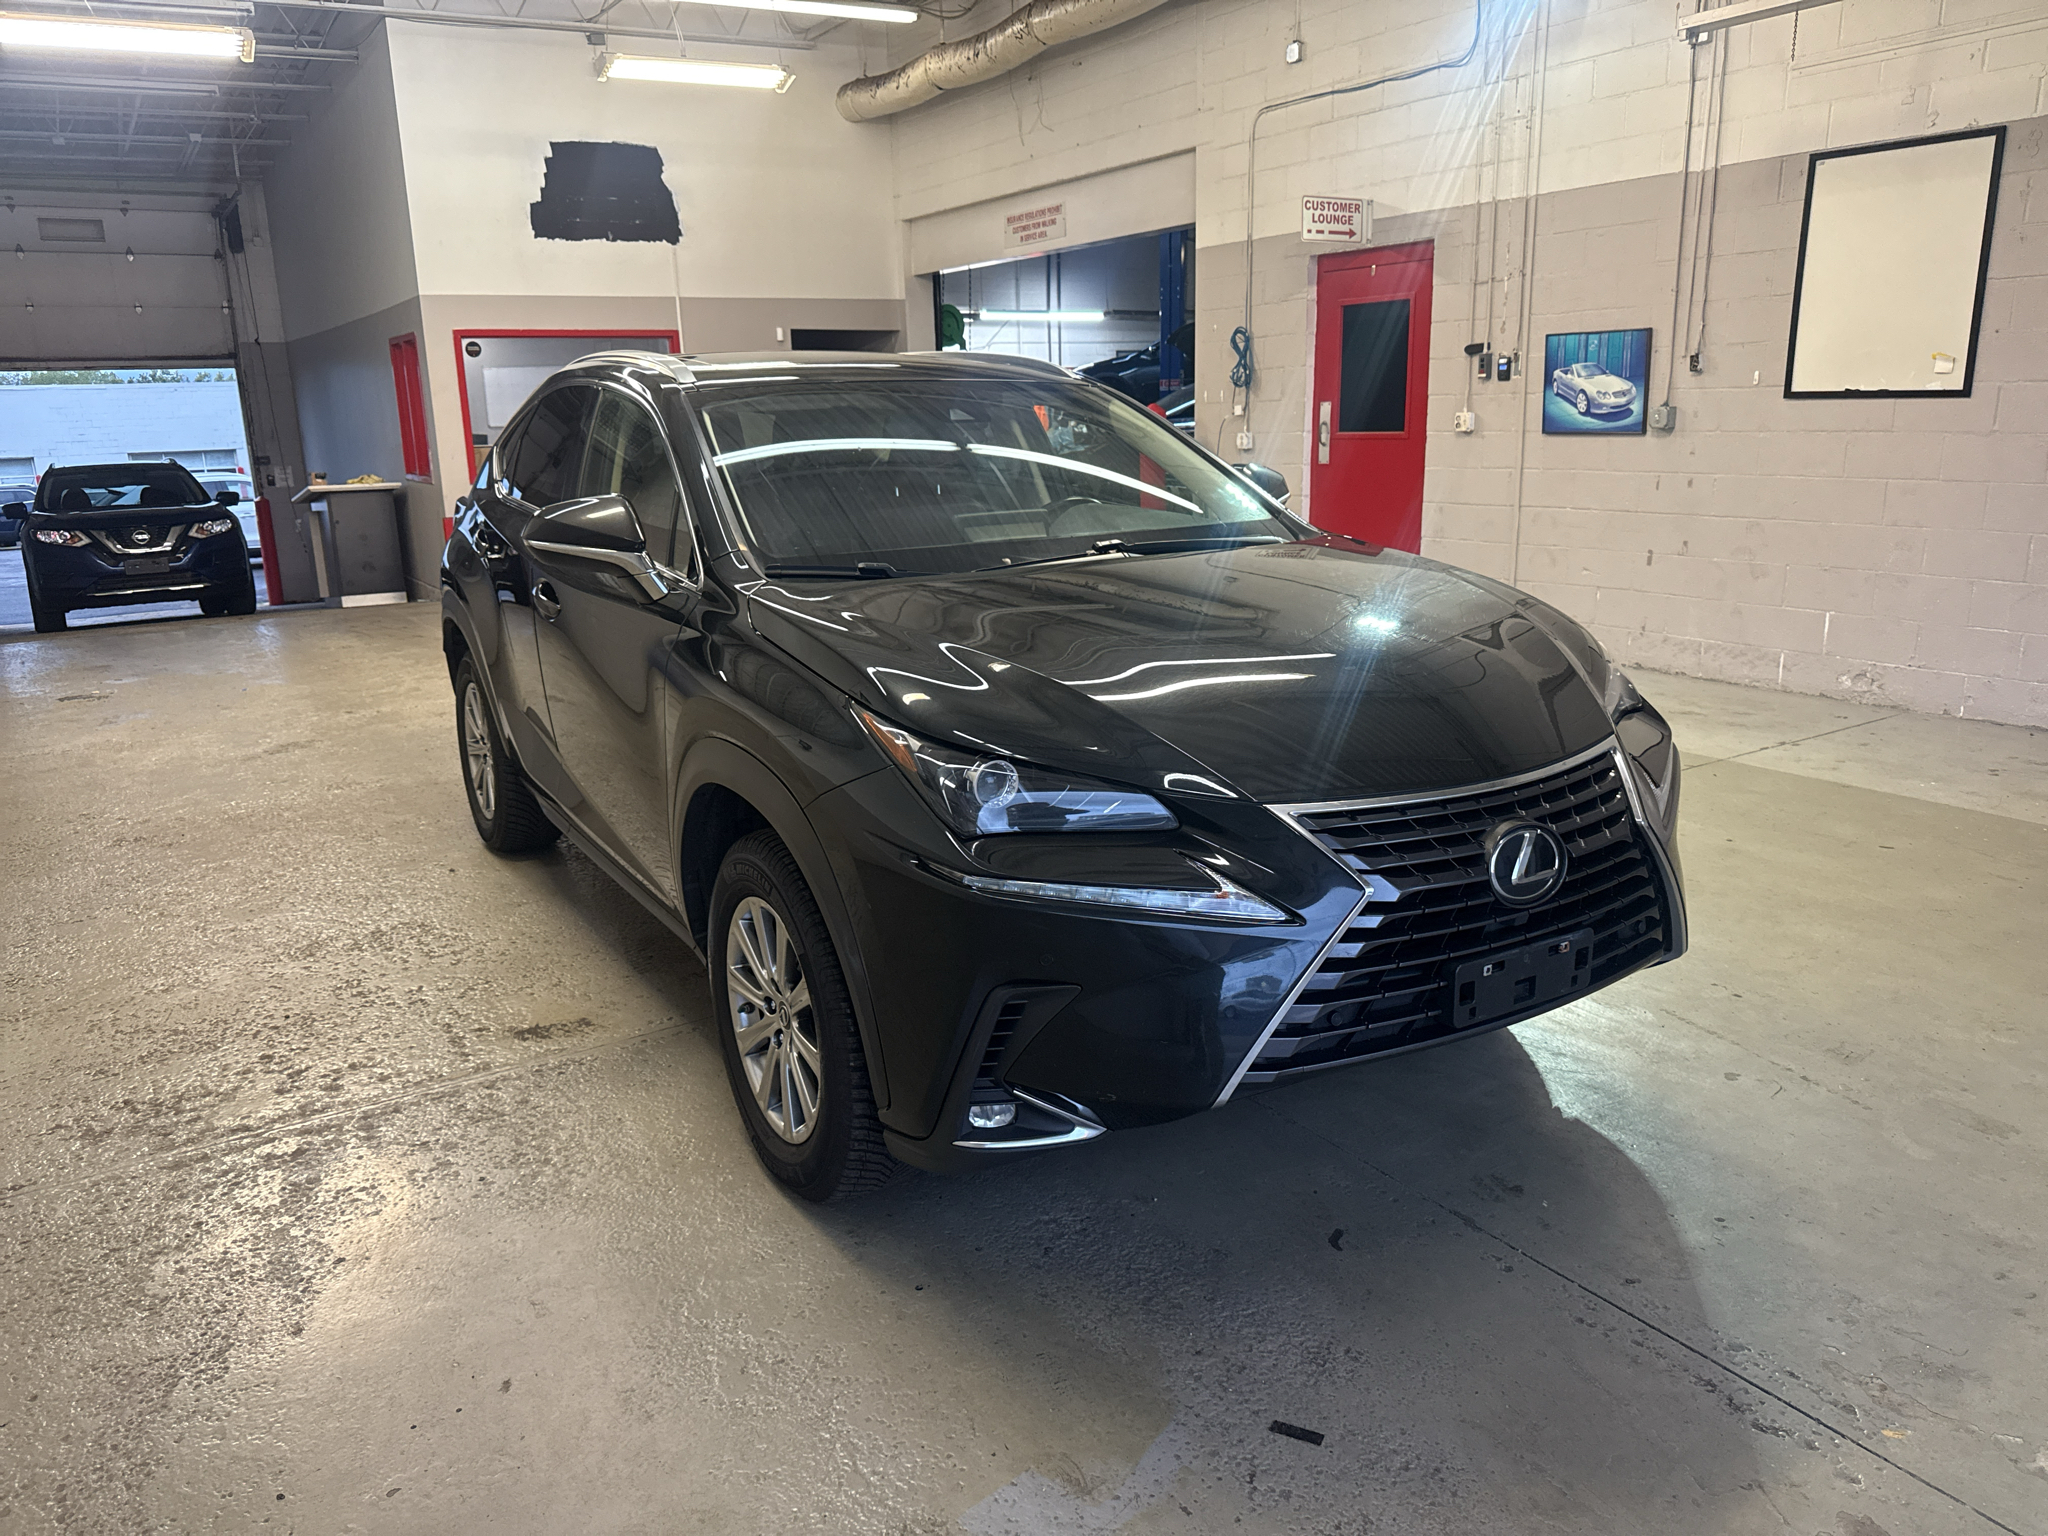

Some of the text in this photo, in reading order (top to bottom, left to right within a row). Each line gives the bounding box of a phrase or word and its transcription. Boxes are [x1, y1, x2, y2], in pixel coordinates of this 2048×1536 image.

[1304, 200, 1361, 214] CUSTOMER
[1312, 213, 1354, 225] LOUNGE
[736, 864, 771, 894] MICHELIN
